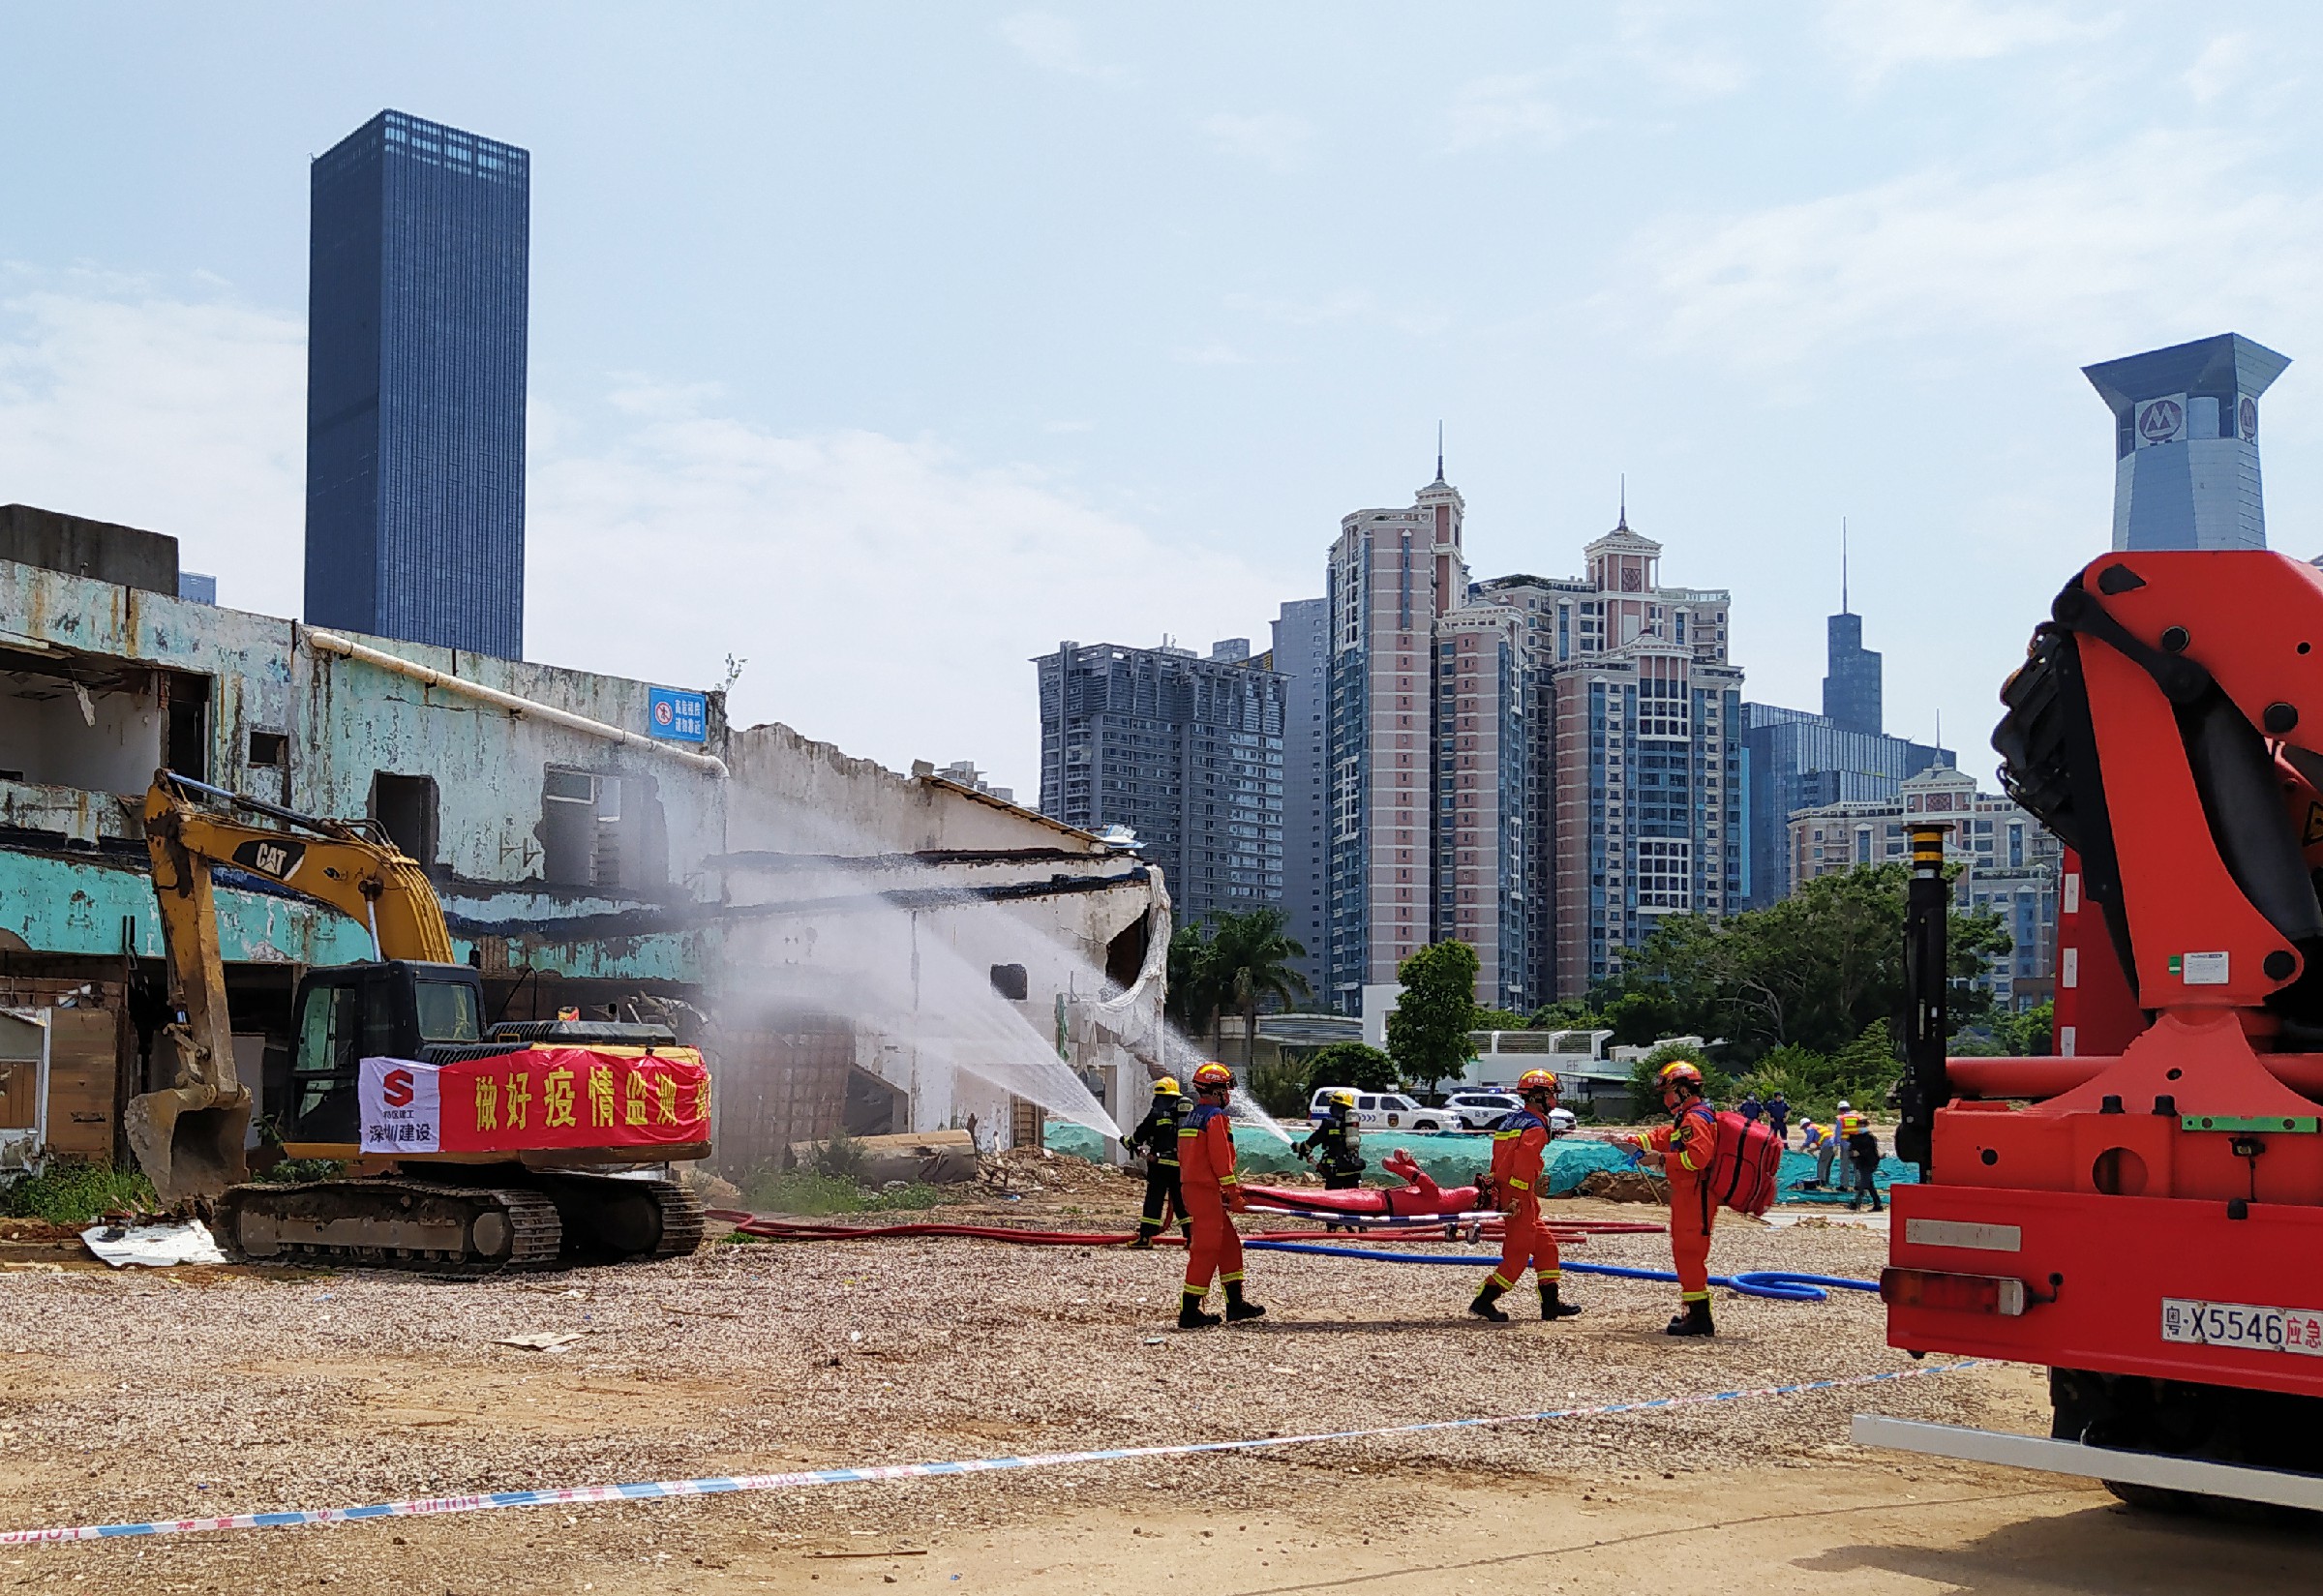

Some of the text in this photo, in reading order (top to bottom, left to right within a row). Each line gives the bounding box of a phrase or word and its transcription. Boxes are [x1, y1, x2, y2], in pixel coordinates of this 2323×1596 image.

[256, 842, 287, 876] CAT
[369, 1123, 431, 1143] 深圳建设
